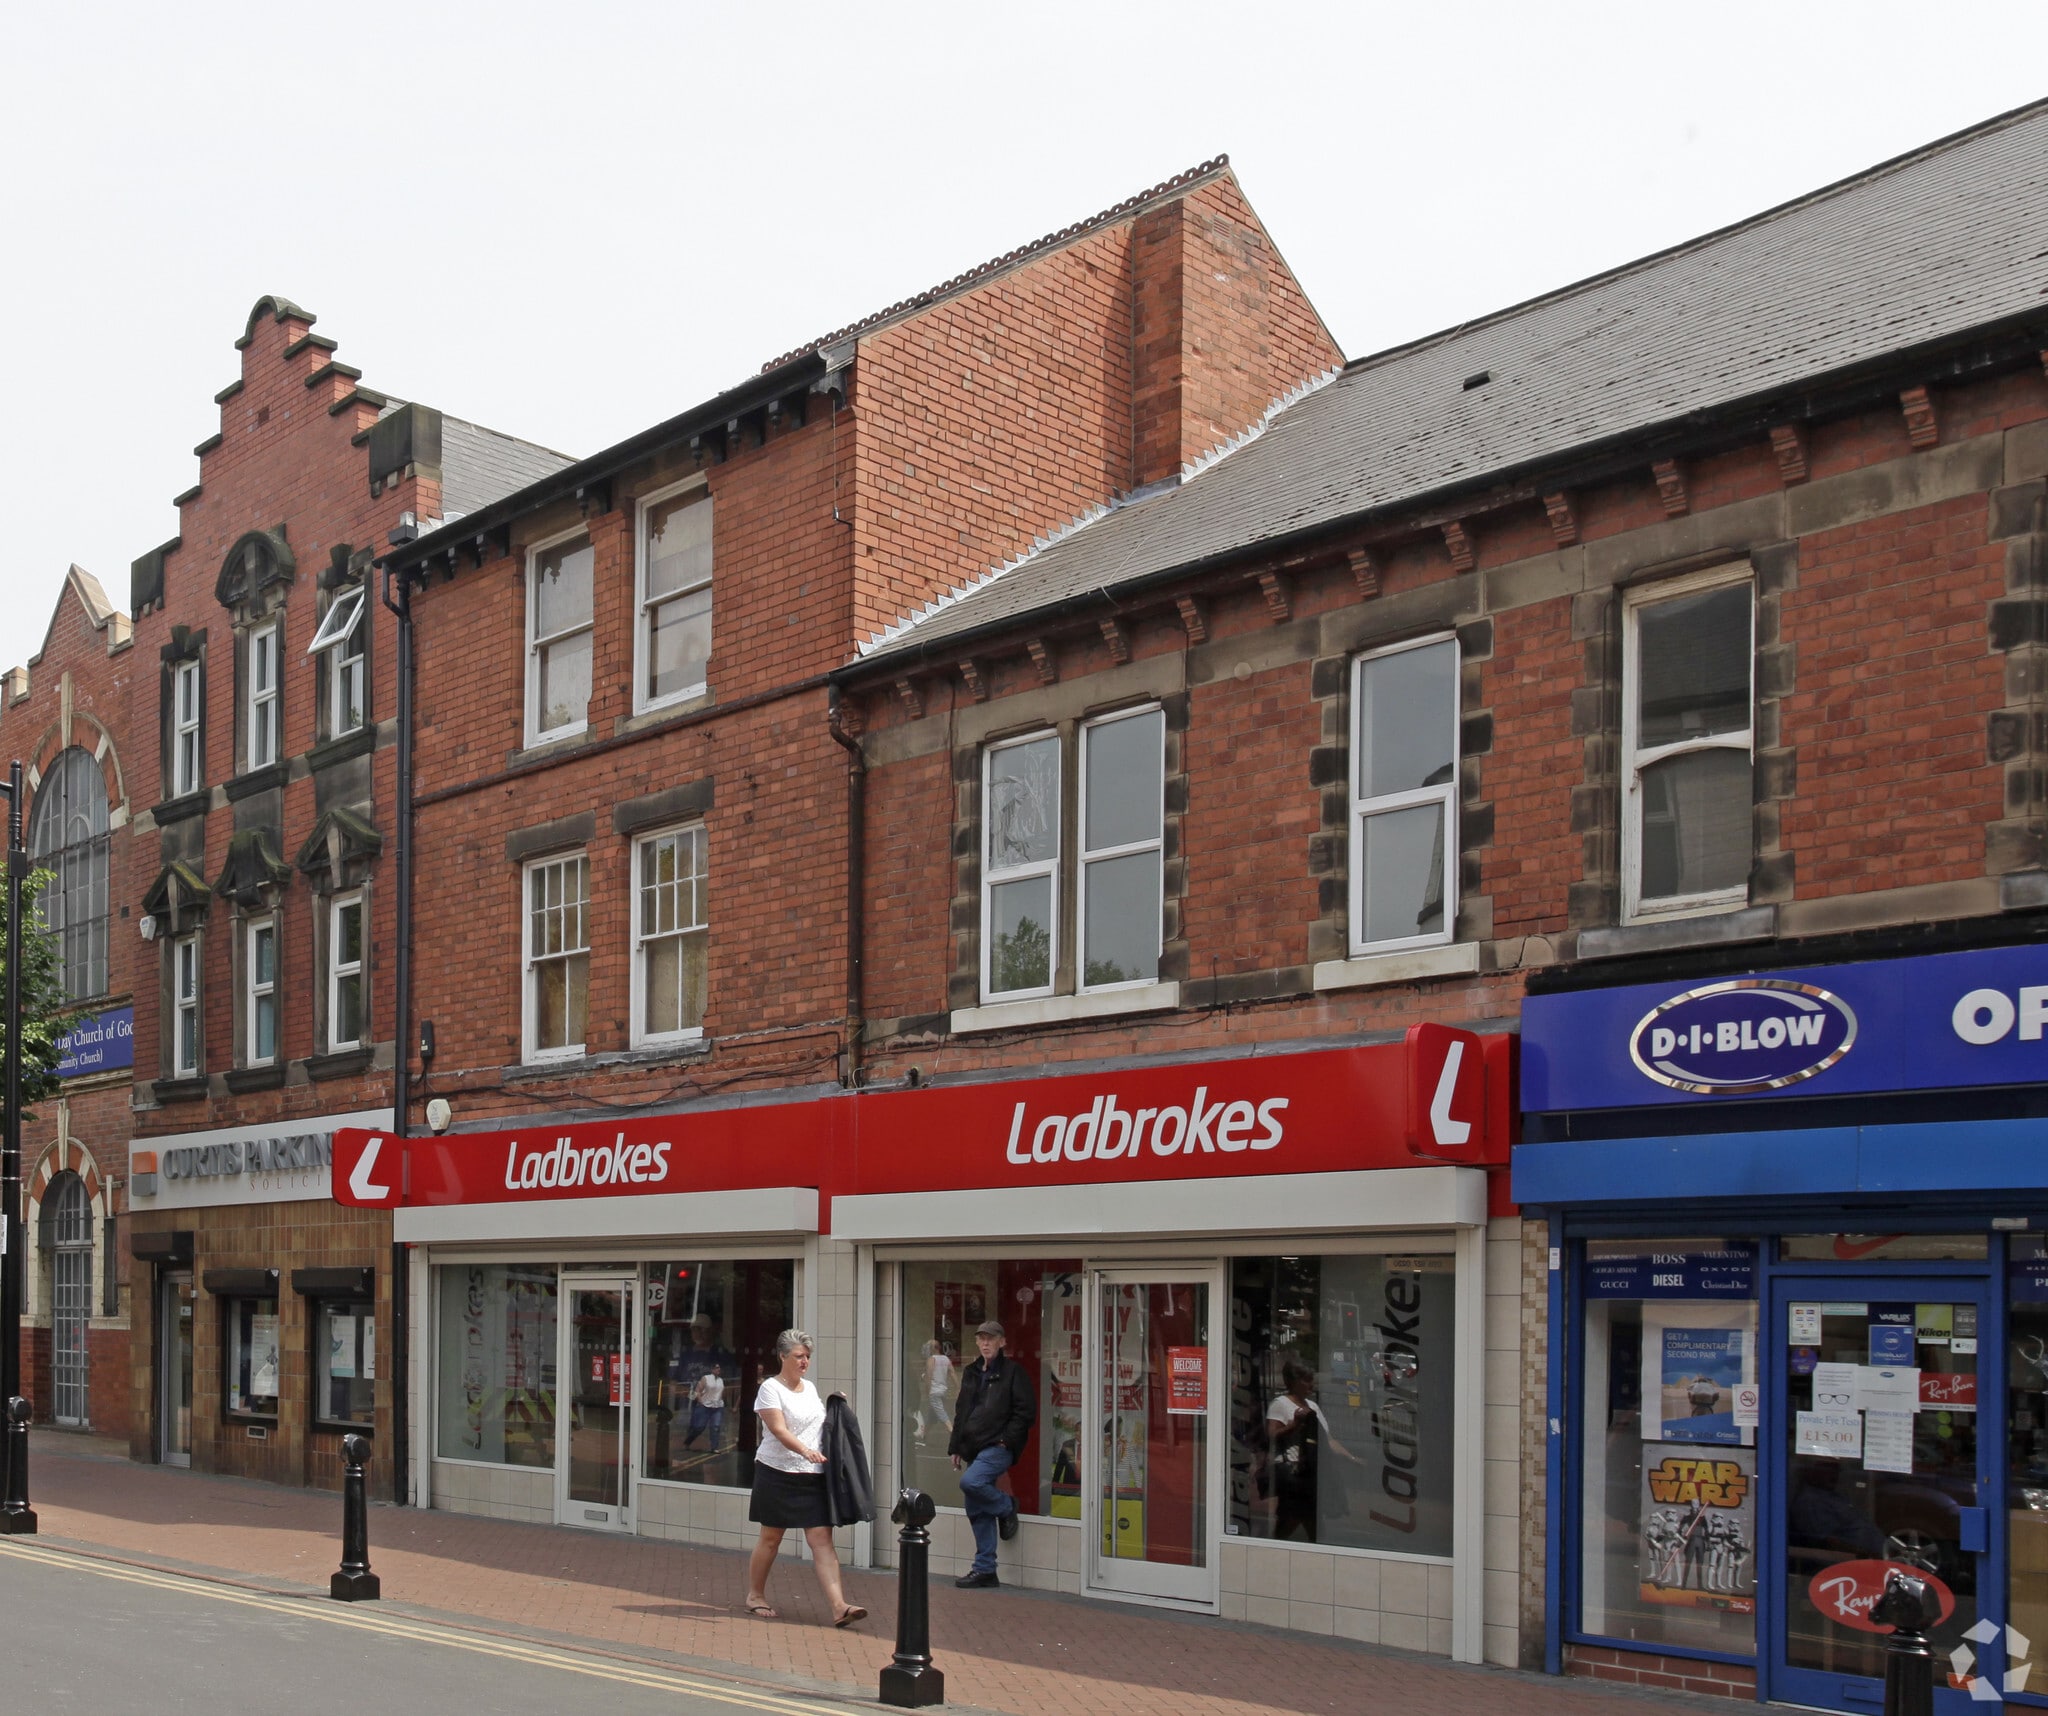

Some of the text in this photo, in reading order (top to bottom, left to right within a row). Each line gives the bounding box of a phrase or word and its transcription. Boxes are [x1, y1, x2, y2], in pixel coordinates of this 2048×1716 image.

[74, 1024, 103, 1046] Church
[106, 1020, 115, 1039] of
[1006, 1086, 1290, 1165] Ladbrokes
[163, 1131, 333, 1180] CURTIS PARKIN
[505, 1132, 671, 1189] Ladbrokes
[1652, 1254, 1686, 1264] BOSS
[1703, 1251, 1749, 1259] VALENTINO
[1653, 1274, 1684, 1286] DIESEL
[1917, 1328, 1951, 1337] Nikon
[1667, 1342, 1731, 1350] COMPLIMENTARY
[1667, 1350, 1698, 1359] SECOND
[1173, 1359, 1202, 1370] WELCOME
[1921, 1375, 1974, 1400] Ray-Ban
[1799, 1415, 1860, 1426] Private Eye Tests
[1804, 1430, 1853, 1443] £15.00
[1650, 1459, 1747, 1486] STAR
[1651, 1480, 1747, 1508] WARS
